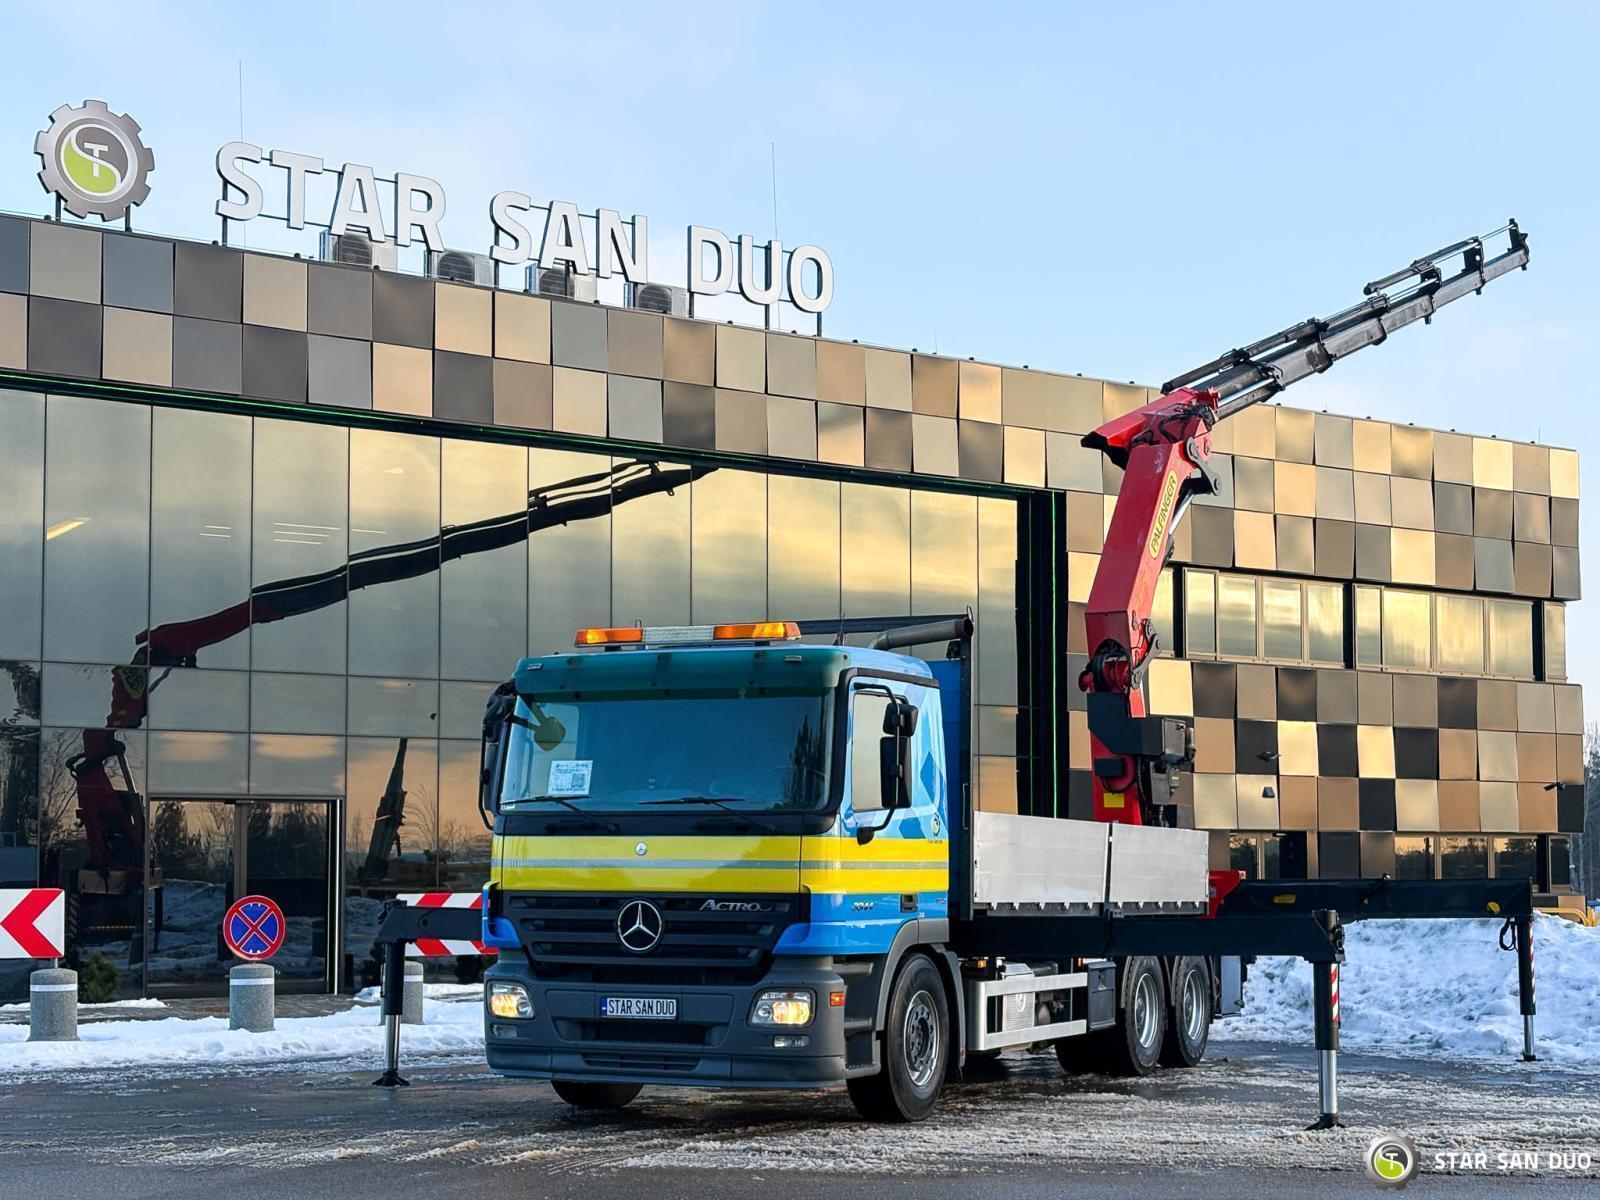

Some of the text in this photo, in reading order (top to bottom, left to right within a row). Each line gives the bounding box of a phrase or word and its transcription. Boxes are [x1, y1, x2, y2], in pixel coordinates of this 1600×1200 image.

[215, 141, 834, 314] STAR SAN DUO
[1150, 474, 1177, 554] PALFINGER
[608, 999, 675, 1016] STAR SAN DUO
